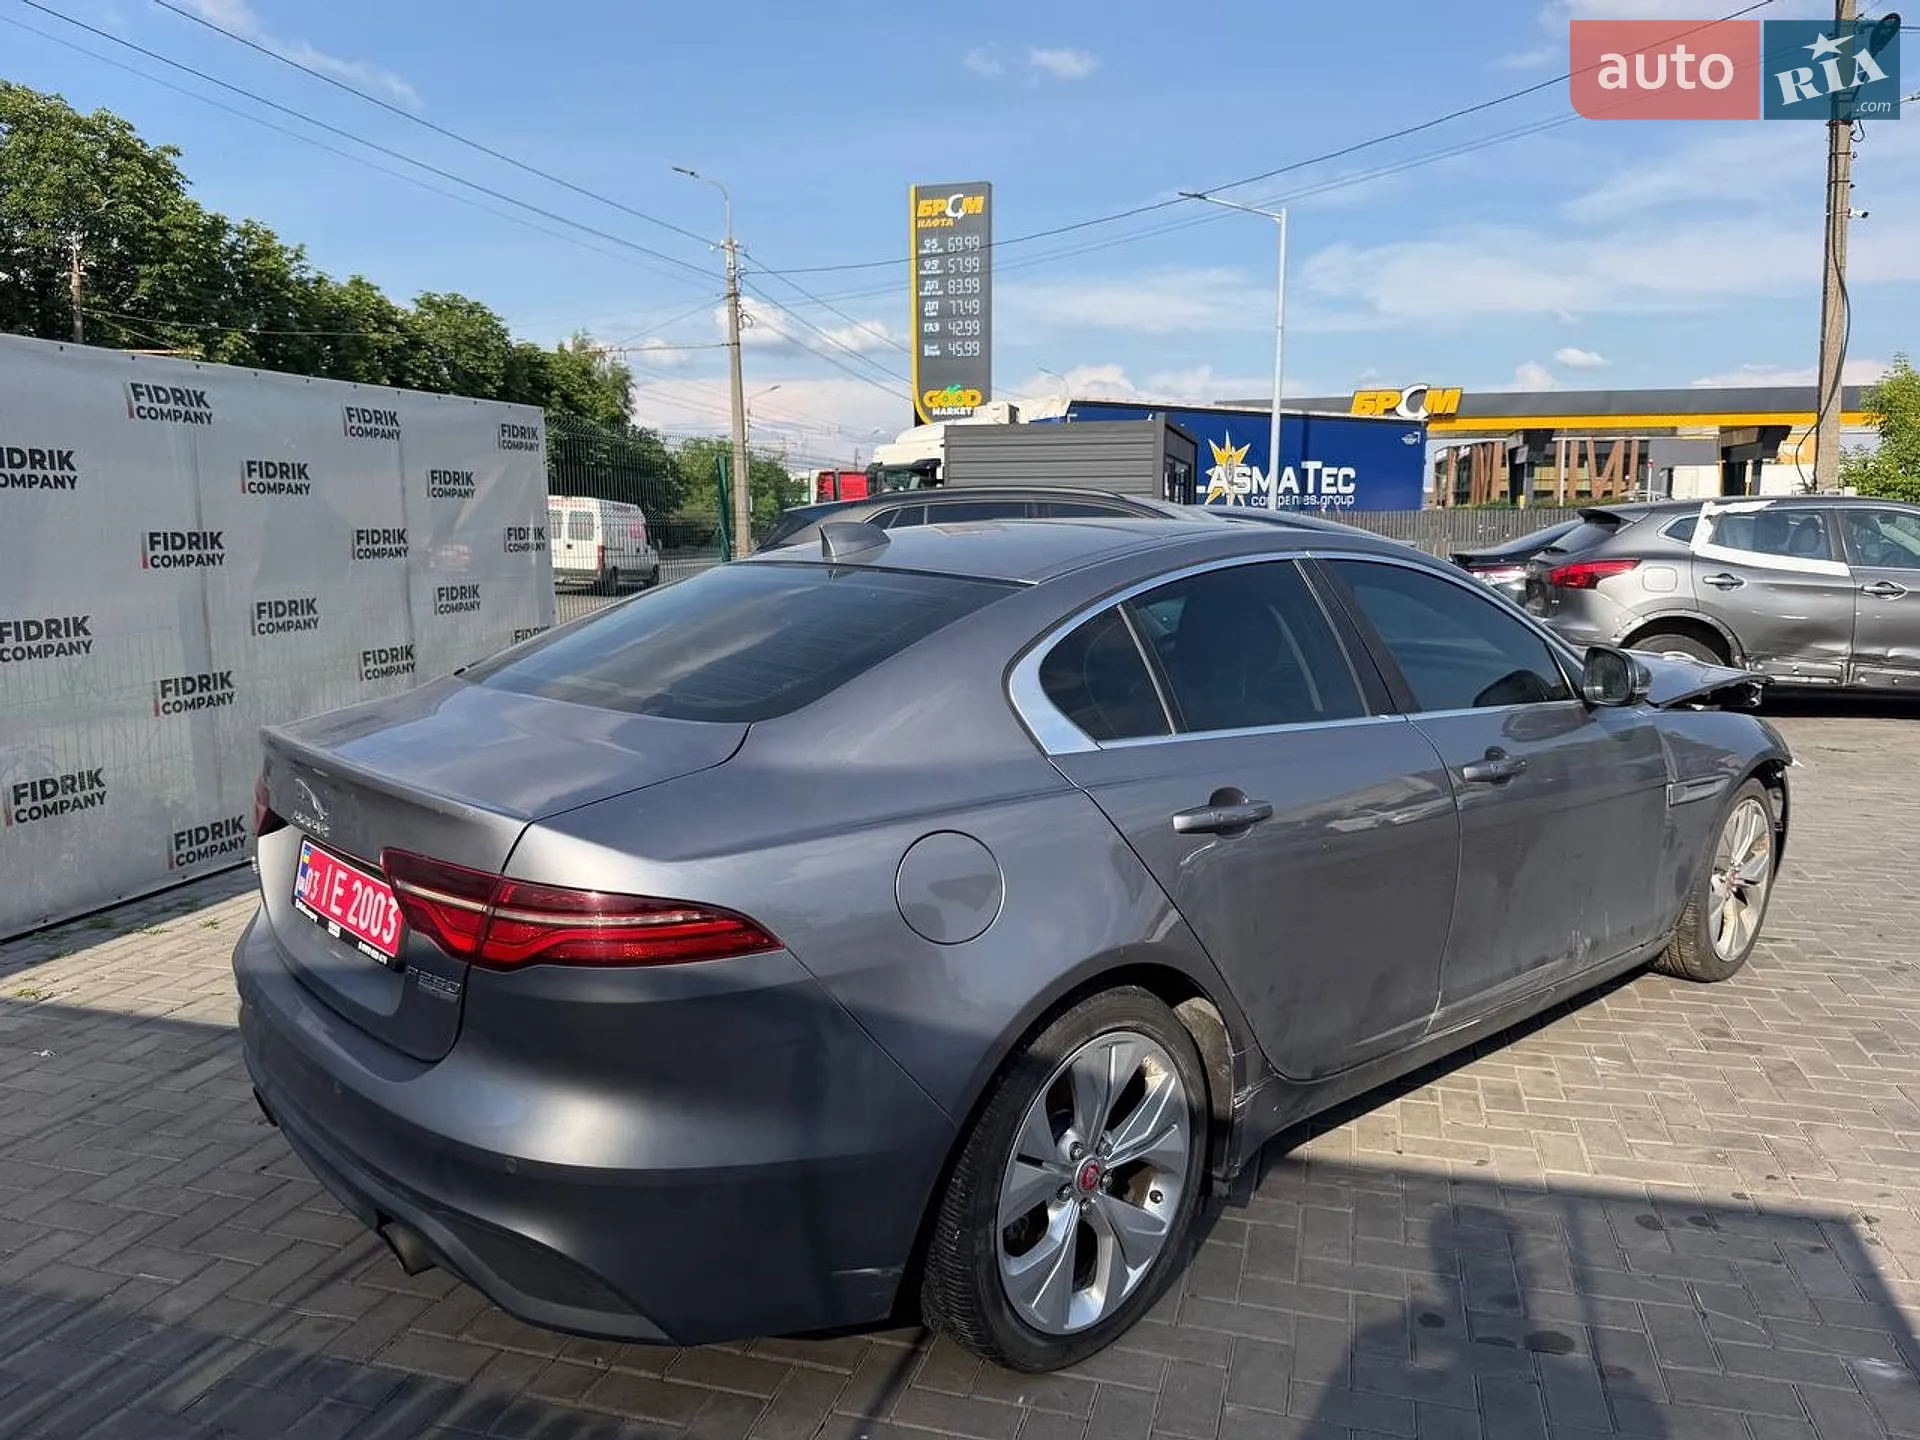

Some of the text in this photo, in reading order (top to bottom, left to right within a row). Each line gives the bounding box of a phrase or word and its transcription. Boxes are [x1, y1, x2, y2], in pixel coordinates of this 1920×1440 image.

[924, 239, 937, 249] 95
[130, 382, 210, 408] FIDRIK
[923, 389, 984, 408] GOOD
[1351, 383, 1464, 420] БРСМ
[136, 405, 213, 424] COMPANY
[345, 406, 400, 427] FIDRIK
[932, 407, 974, 416] MARKET
[349, 425, 401, 441] COMPANY
[500, 423, 538, 440] FIDRIK
[502, 439, 539, 451] COMPANY
[0, 447, 76, 472] IDRIK
[246, 460, 311, 480] FIDRIK
[430, 470, 475, 487] FIDRIK
[0, 473, 78, 490] OMPANY
[247, 482, 311, 496] COMPANY
[431, 487, 476, 499] COMPANY
[148, 531, 224, 552] FIDRIK
[356, 529, 407, 545] FIDRIK
[150, 552, 226, 568] COMPANY
[357, 547, 409, 560] COMPANY
[437, 584, 480, 602] FIDRIK
[256, 598, 318, 620] FIDRIK
[438, 601, 481, 614] COMPANY
[0, 616, 92, 644] FIDRIK
[257, 619, 320, 636] COMPANY
[0, 640, 93, 662] COMPANY
[363, 645, 415, 667] FIDRIK
[364, 661, 417, 681] COMPANY
[160, 670, 234, 700] FIDRIK
[162, 692, 236, 716] COMPANY
[12, 768, 106, 806] FIDRIK
[14, 791, 108, 824] COMPANY
[174, 815, 246, 850] FIDRIK
[176, 835, 248, 868] COMPANY
[306, 868, 321, 901] 03
[321, 864, 348, 916] IE
[347, 880, 399, 945] 2003
